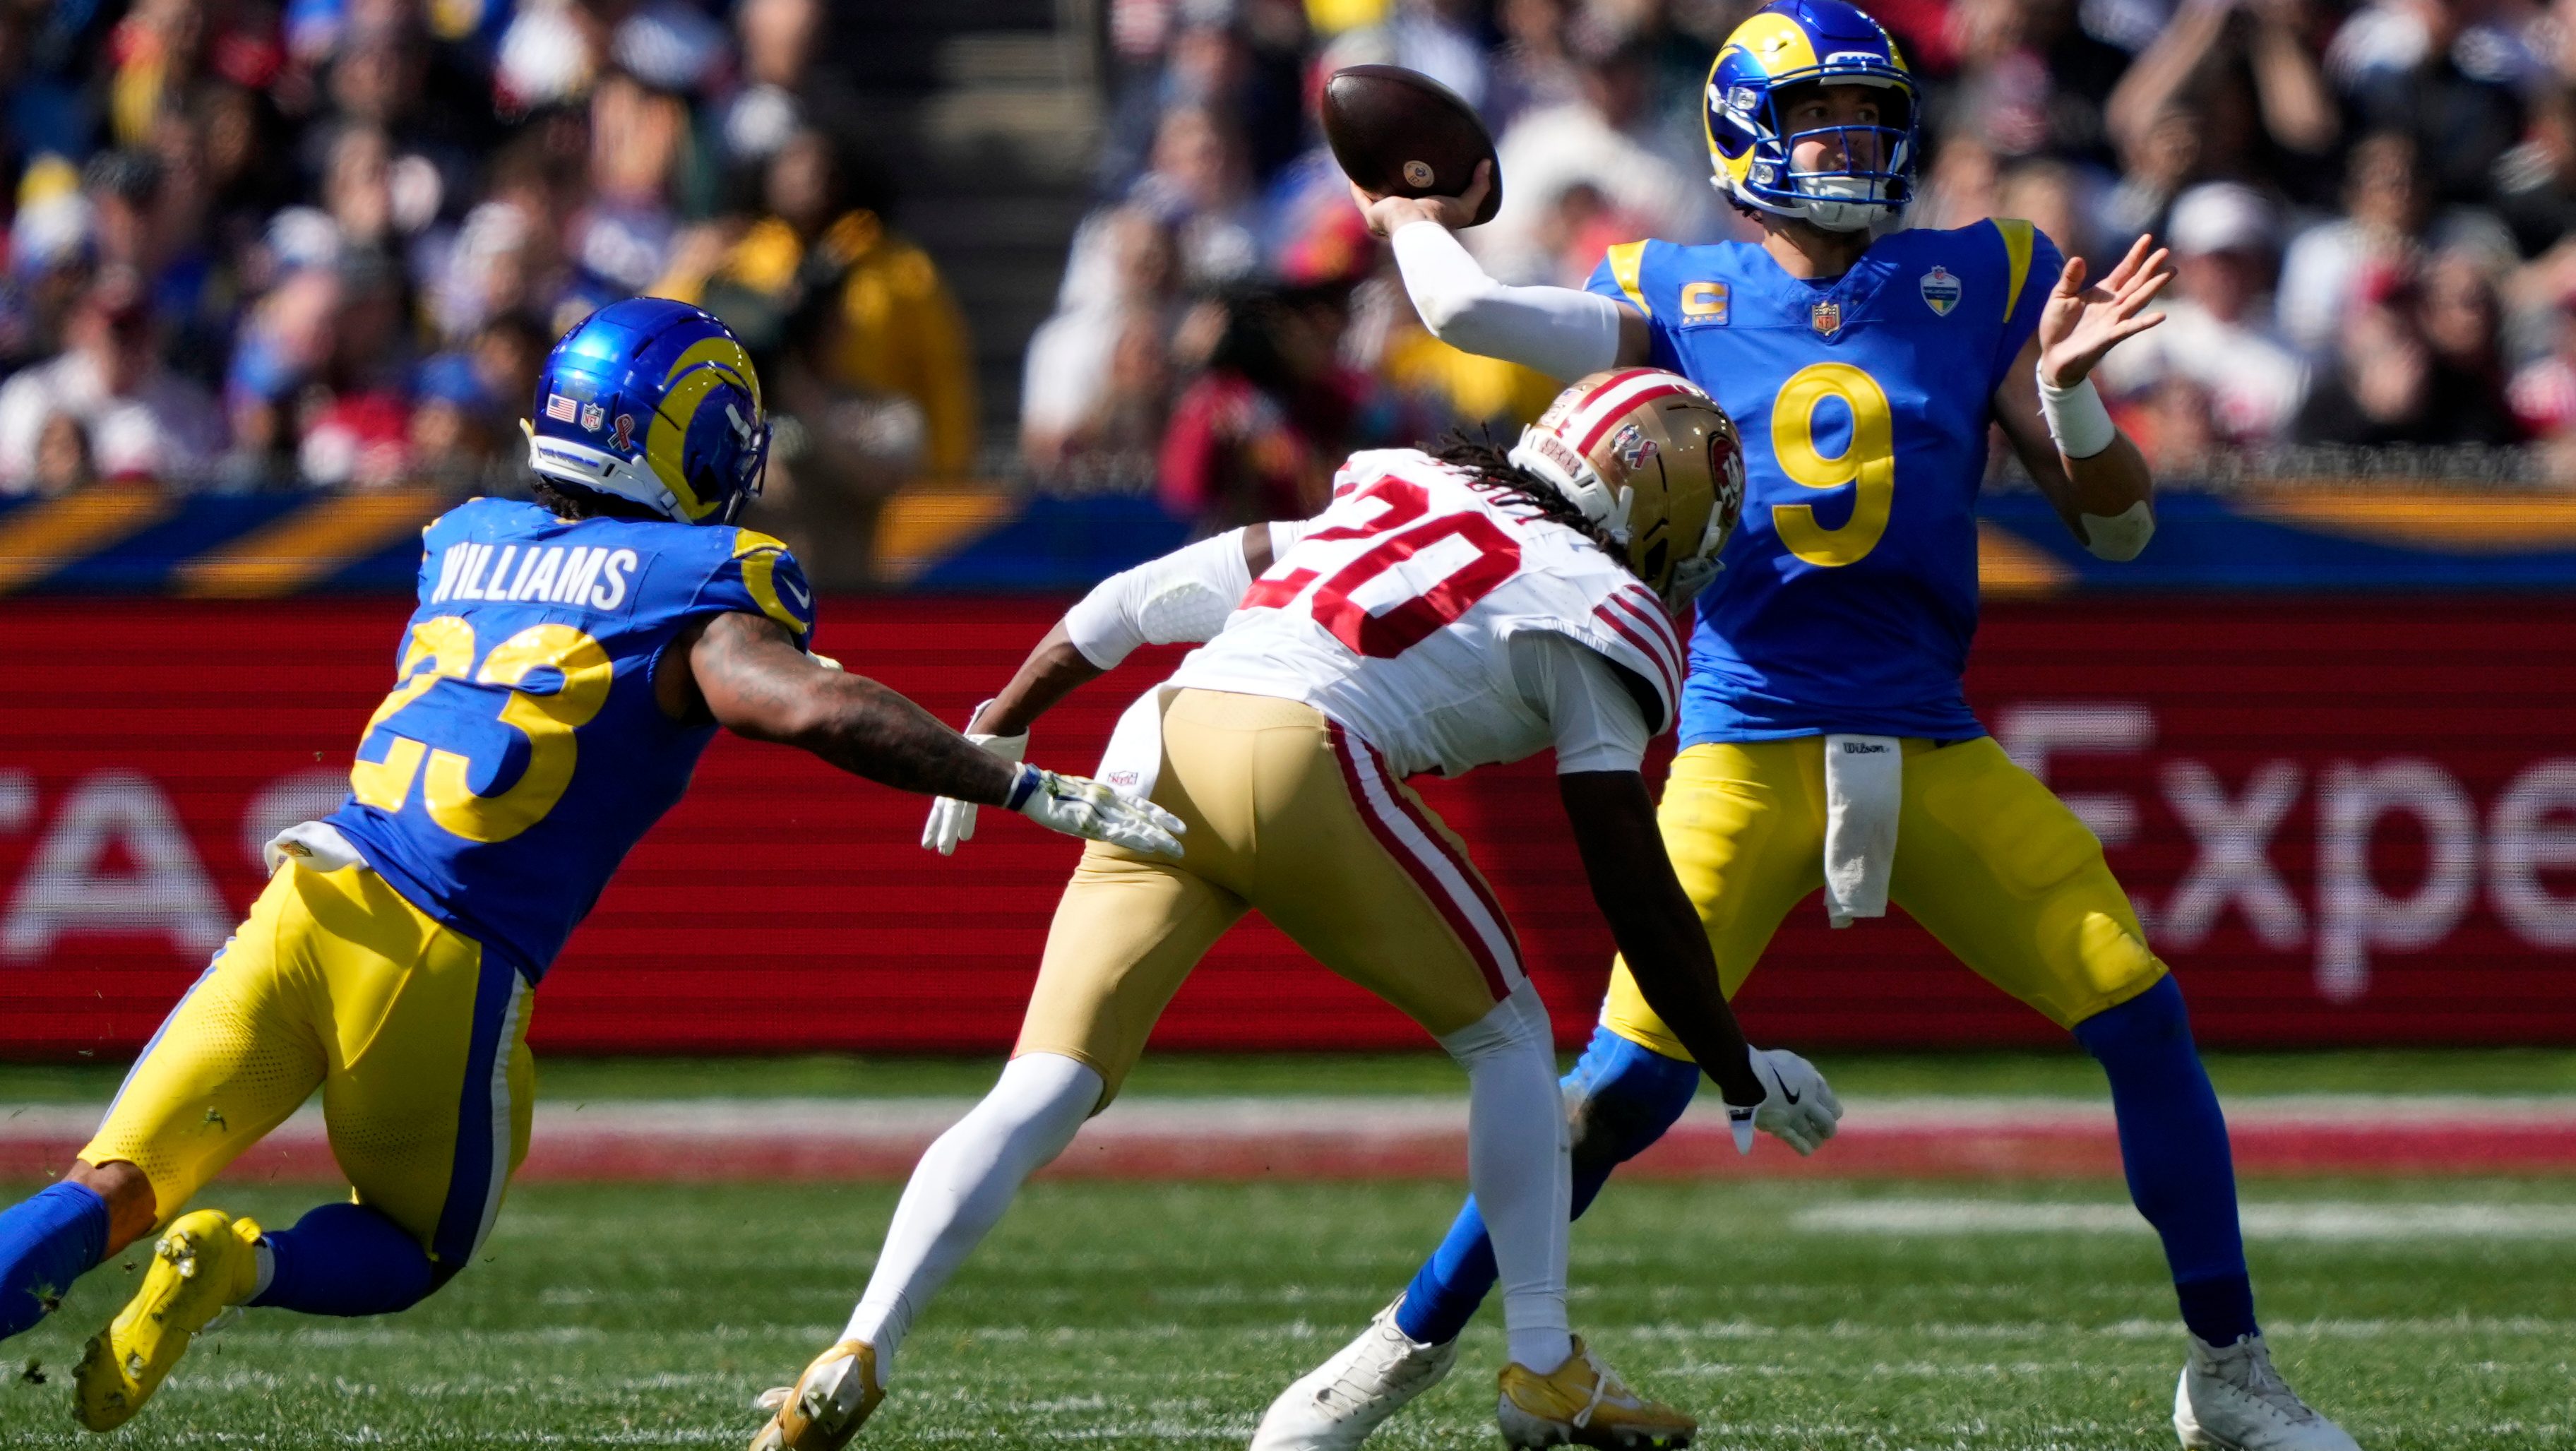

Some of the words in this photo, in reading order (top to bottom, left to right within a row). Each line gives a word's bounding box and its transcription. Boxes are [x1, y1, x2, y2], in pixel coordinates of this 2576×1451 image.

[1681, 282, 1727, 316] C
[584, 414, 600, 428] NFL
[1771, 362, 1895, 567] 9
[431, 542, 638, 611] WILLIAMS
[1239, 474, 1522, 659] 20
[350, 616, 613, 844] 23
[1842, 742, 1886, 754] Wilson
[1111, 775, 1133, 785] NFL
